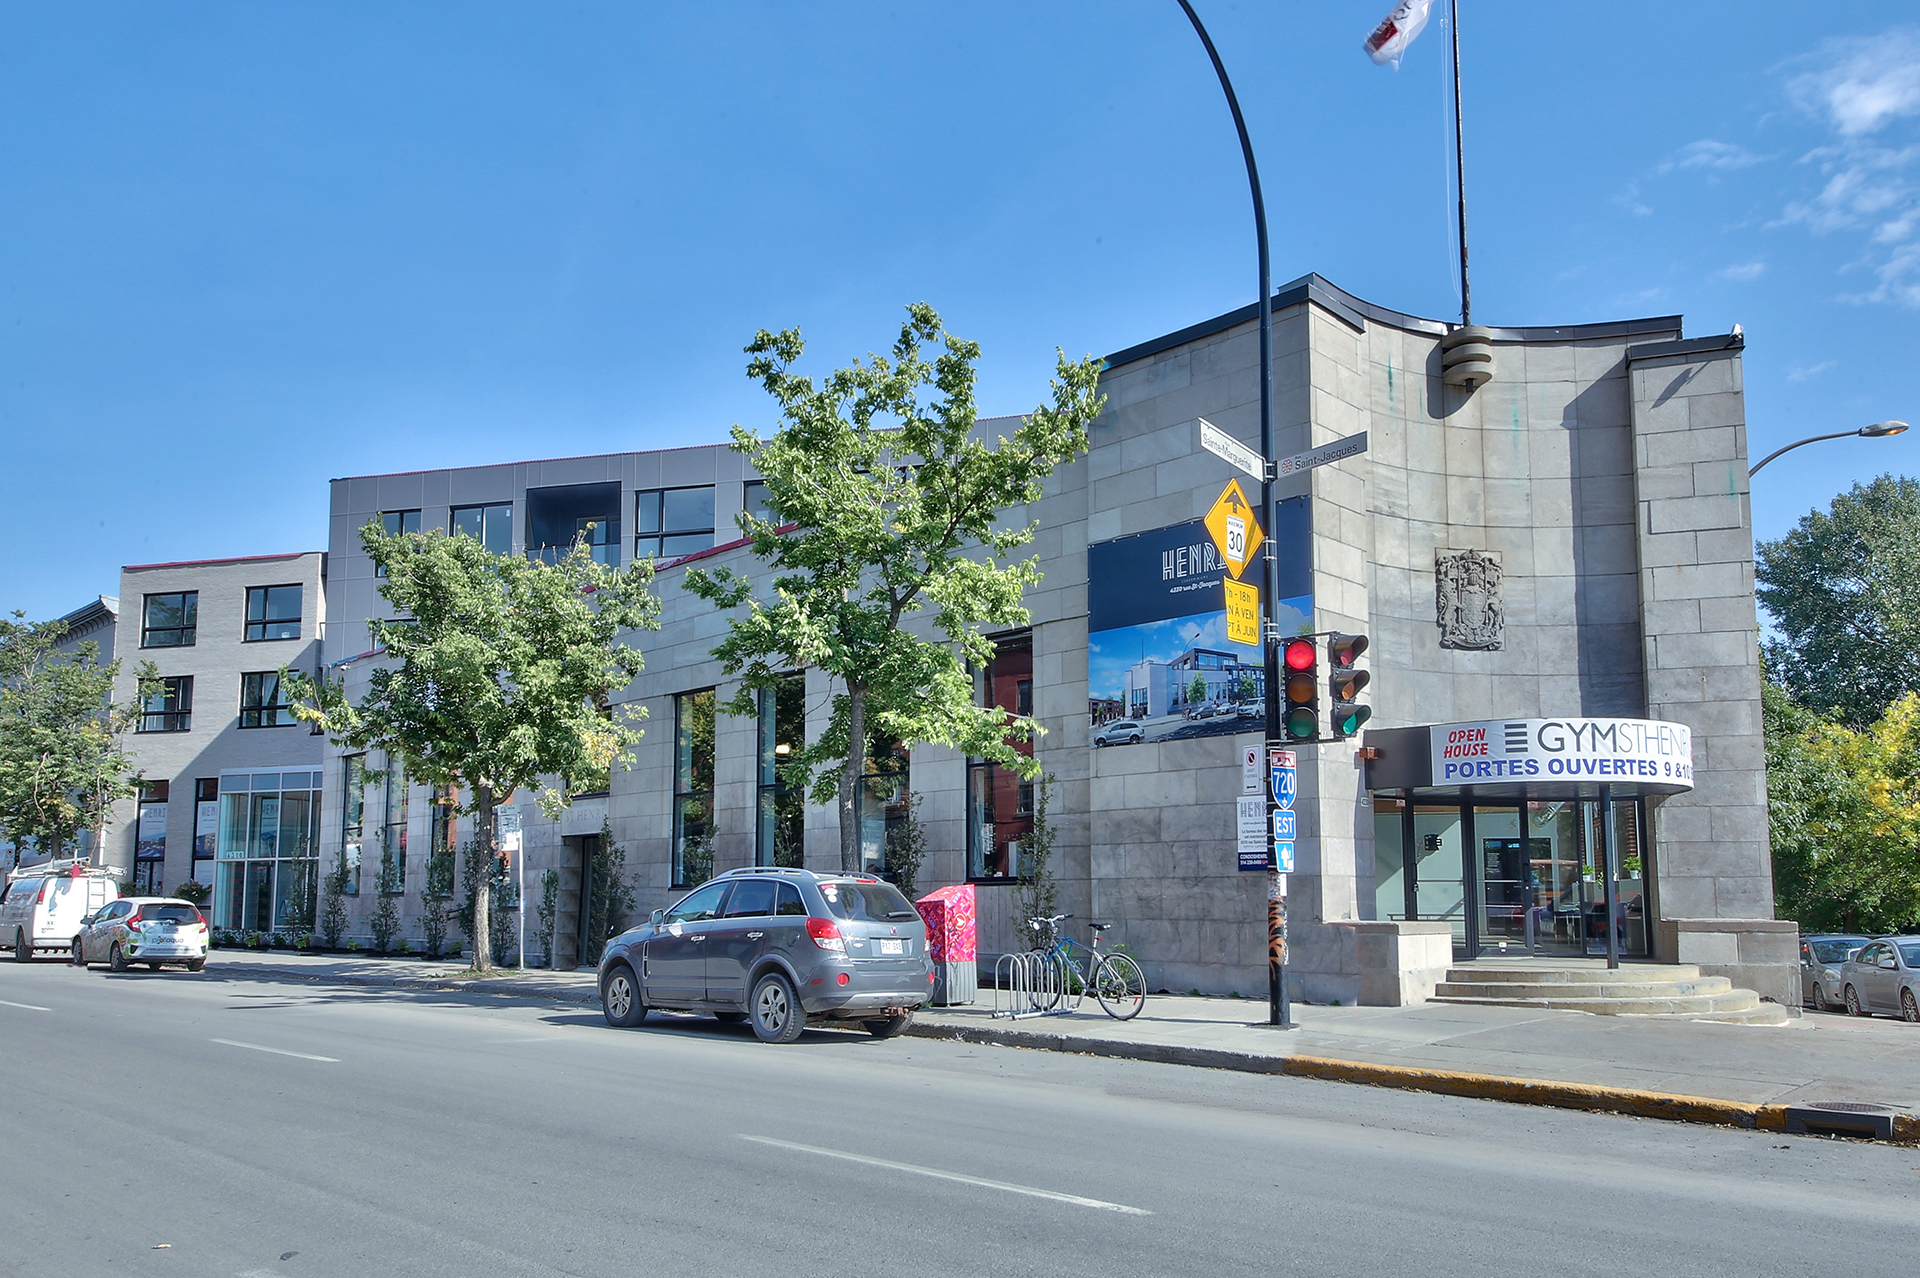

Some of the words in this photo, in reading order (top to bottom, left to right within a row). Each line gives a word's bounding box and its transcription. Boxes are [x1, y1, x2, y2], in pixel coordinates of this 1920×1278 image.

[1295, 443, 1358, 470] Saint-Jacques
[1228, 530, 1243, 553] 30
[1239, 590, 1251, 603] 18h
[1240, 607, 1254, 620] VEN
[1242, 625, 1257, 637] JUIN
[1448, 728, 1487, 744] OPEN
[1443, 742, 1489, 759] HOUSE
[1445, 758, 1540, 780] PORTES
[1547, 757, 1658, 777] OUVERTES
[1664, 761, 1671, 777] 9
[1273, 771, 1295, 795] 720
[1276, 816, 1294, 834] EST
